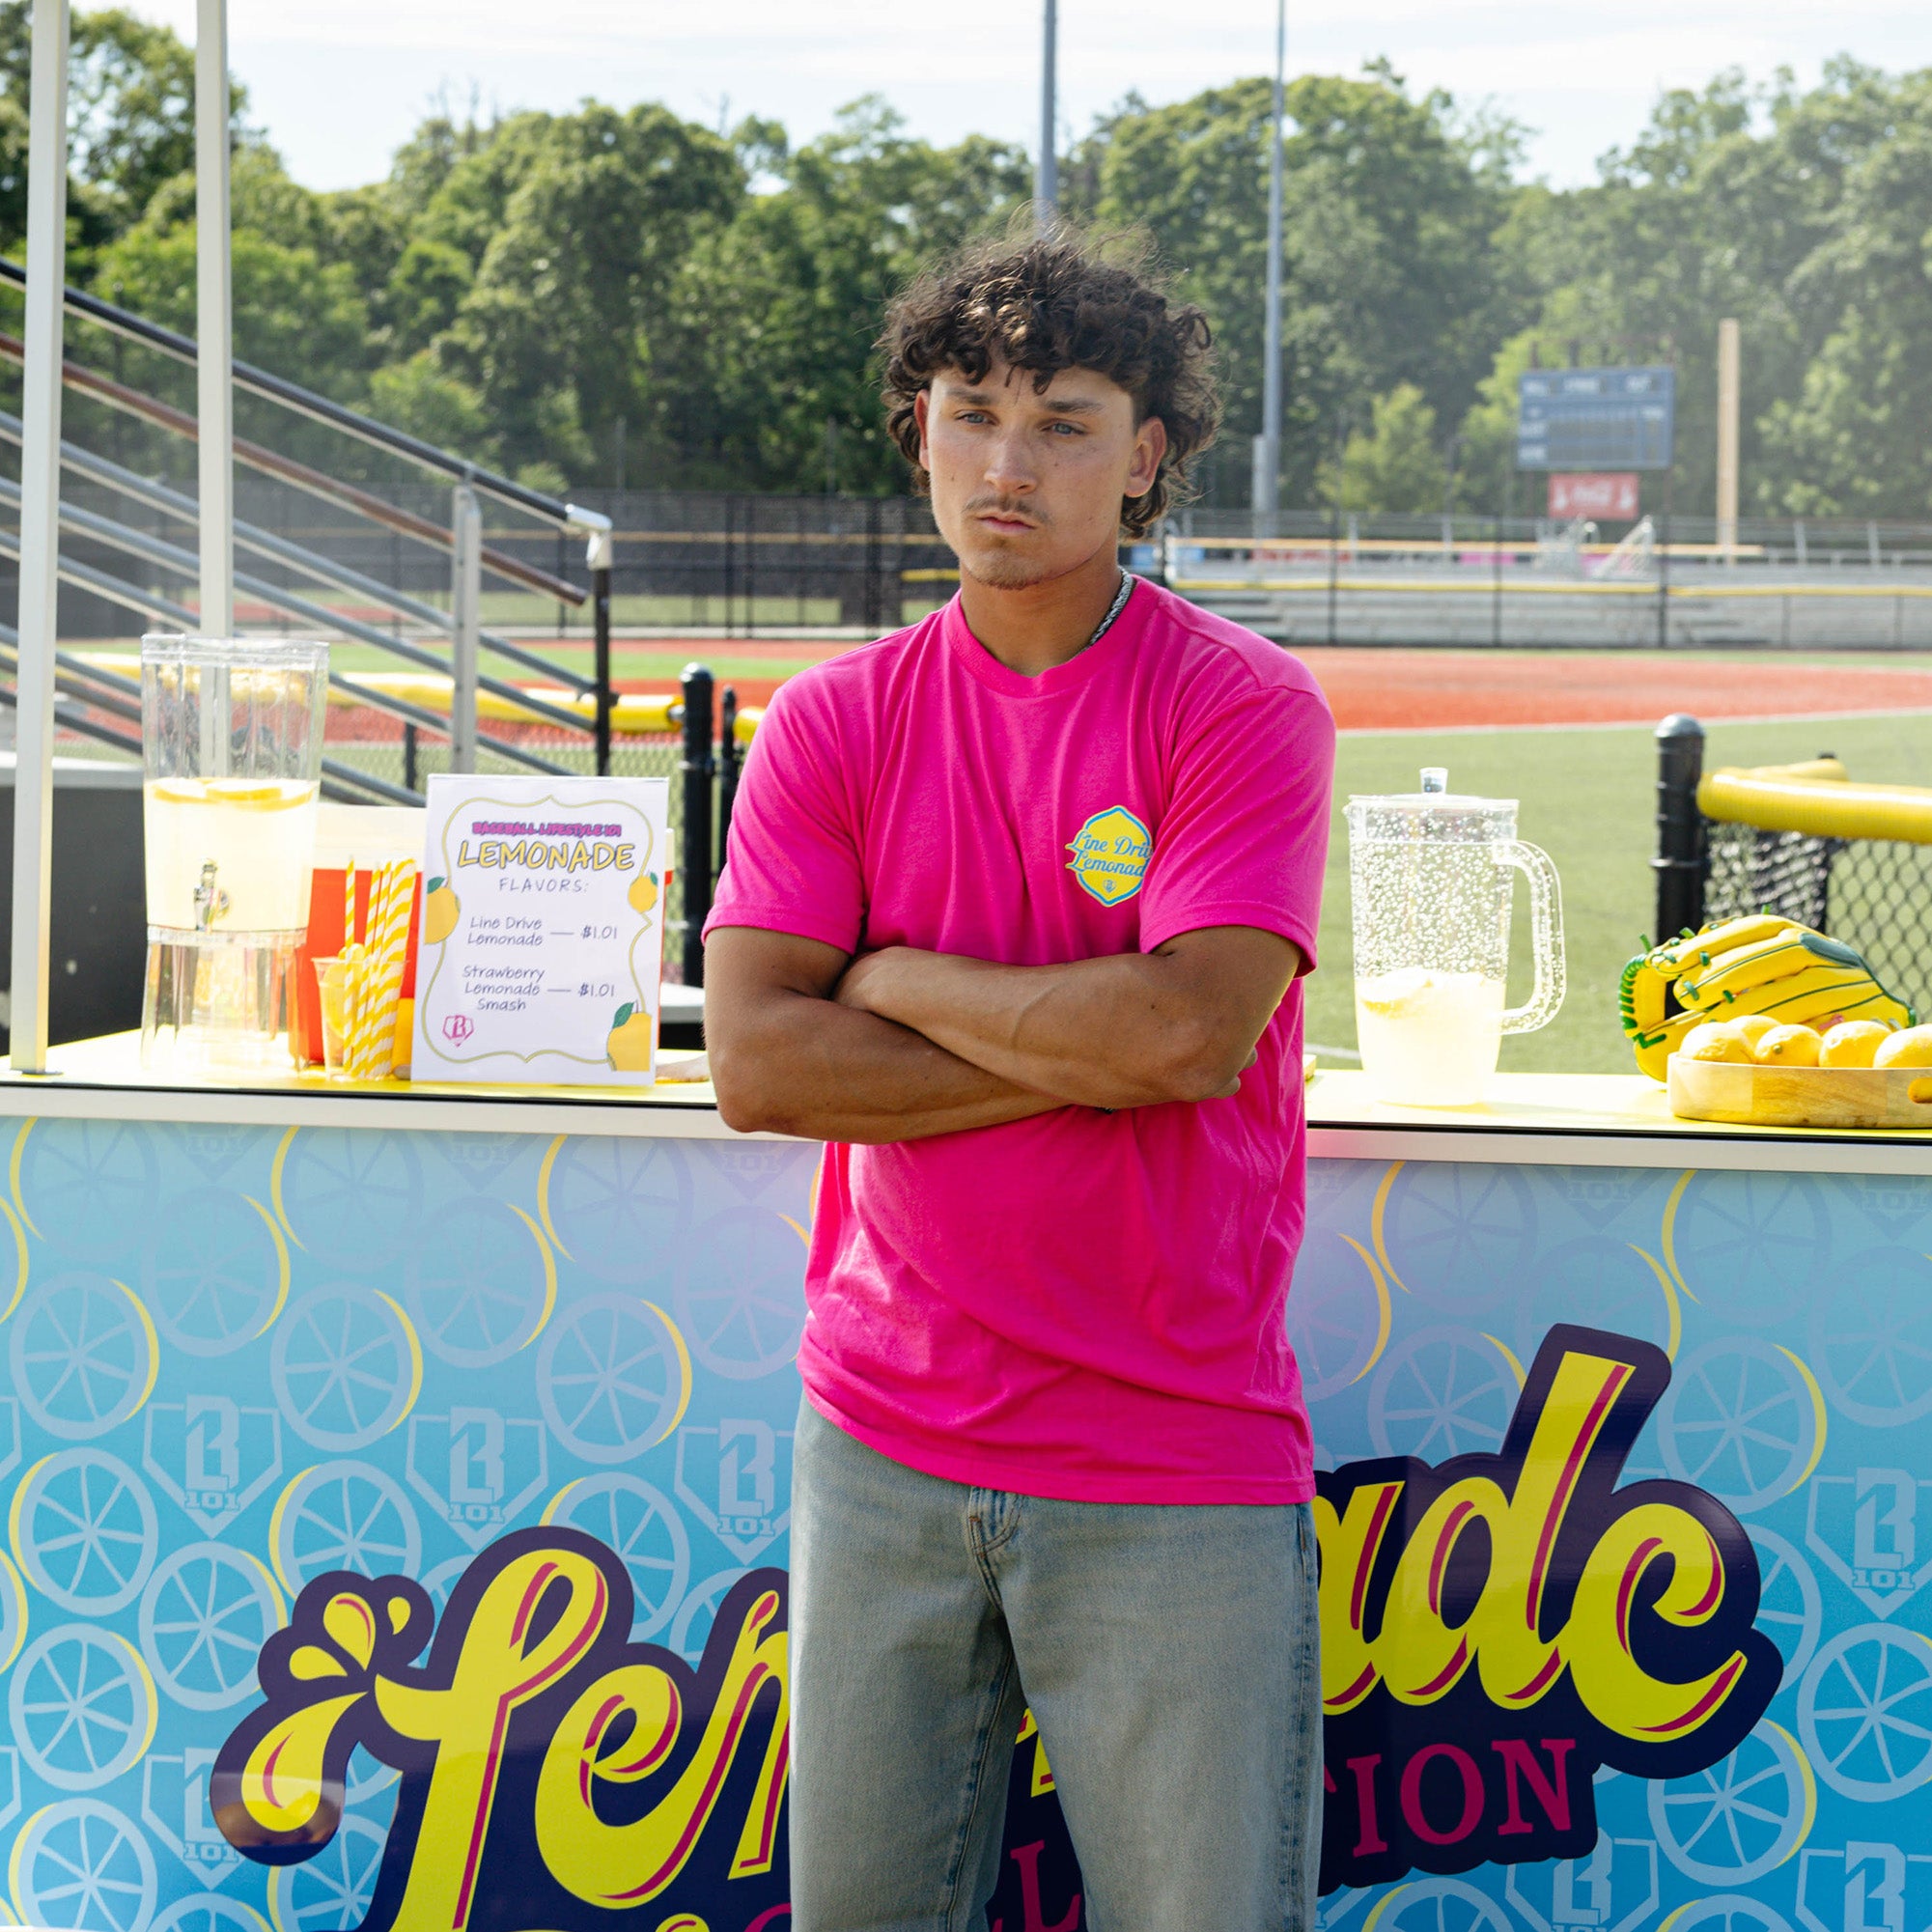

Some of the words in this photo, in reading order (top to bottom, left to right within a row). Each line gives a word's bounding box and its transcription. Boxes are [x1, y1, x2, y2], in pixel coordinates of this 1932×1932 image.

[472, 821, 535, 836] BASEBALL
[1067, 829, 1108, 854] Line
[458, 839, 635, 873] LEMONADE
[1067, 850, 1146, 877] Lemonad
[499, 878, 590, 893] FLAVORS:
[469, 916, 500, 930] Line
[505, 916, 543, 930] Drive
[581, 924, 618, 939] $1.01
[467, 932, 544, 946] Lemonade
[462, 965, 545, 983] Strawberry
[464, 982, 541, 996] Lemonade
[579, 981, 615, 997] $1.01
[476, 996, 526, 1012] Smash
[185, 1491, 239, 1511] 101
[449, 1503, 505, 1524] 101
[717, 1516, 775, 1536] 101
[1852, 1569, 1916, 1590] 101
